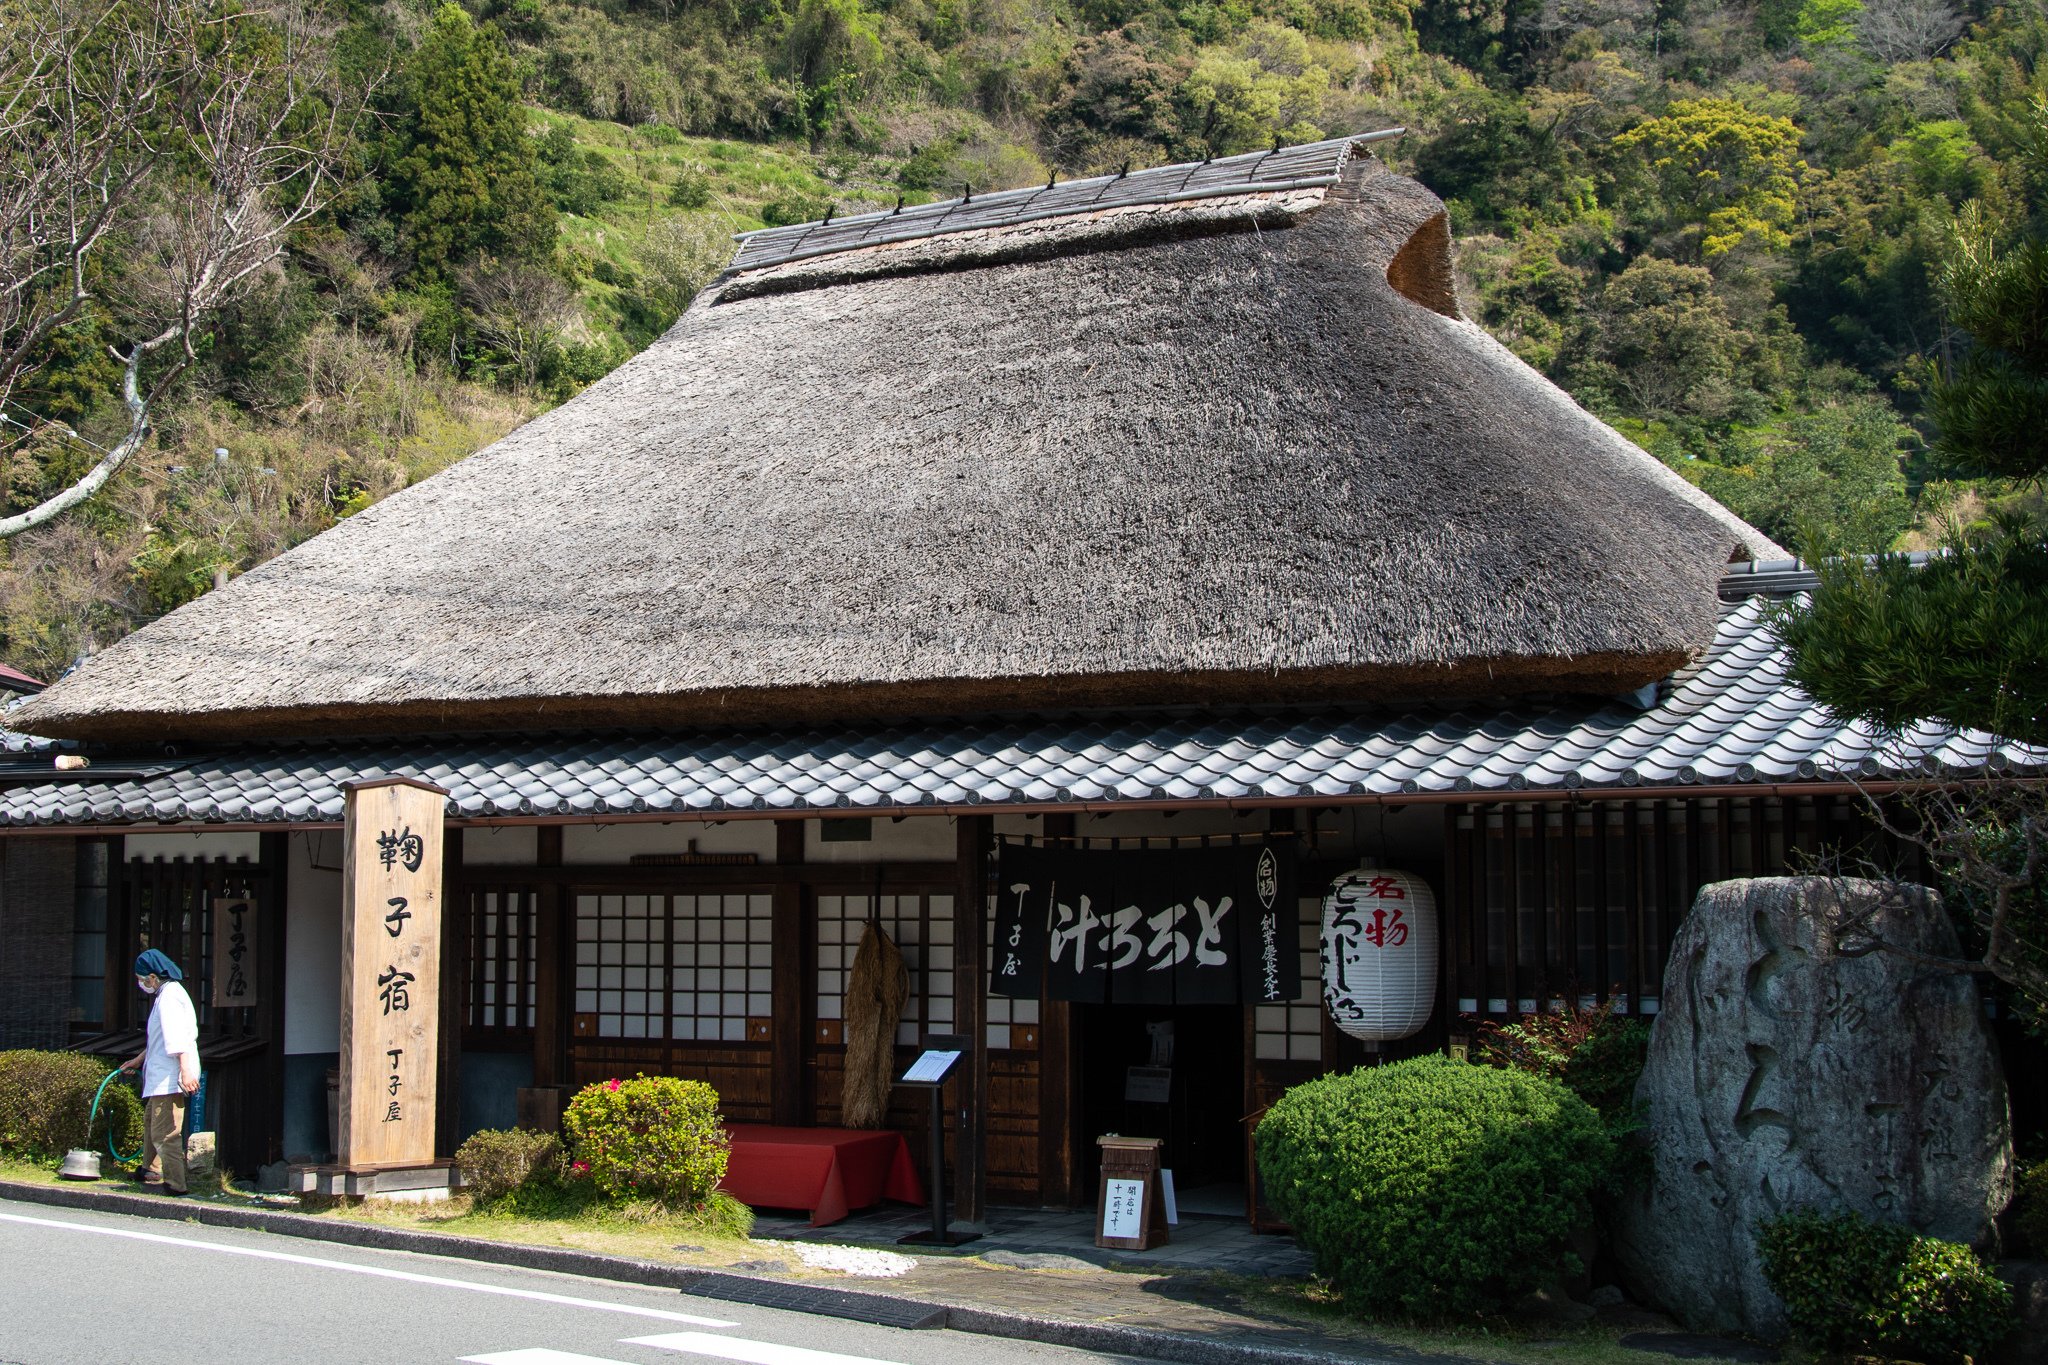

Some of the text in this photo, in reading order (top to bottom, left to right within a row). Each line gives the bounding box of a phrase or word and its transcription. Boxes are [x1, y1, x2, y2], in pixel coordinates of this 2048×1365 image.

[1259, 857, 1275, 897] 名物
[1365, 875, 1409, 948] 名物
[225, 903, 249, 997] 丁子屋
[1001, 882, 1031, 976] 丁子屋
[1049, 894, 1233, 974] とろろ汁
[1260, 912, 1280, 1001] 創業慶長元年
[376, 825, 424, 1124] 鞠子宿 丁子屋
[1125, 1185, 1137, 1216] 開店は
[1863, 1102, 1904, 1211] 丁子
